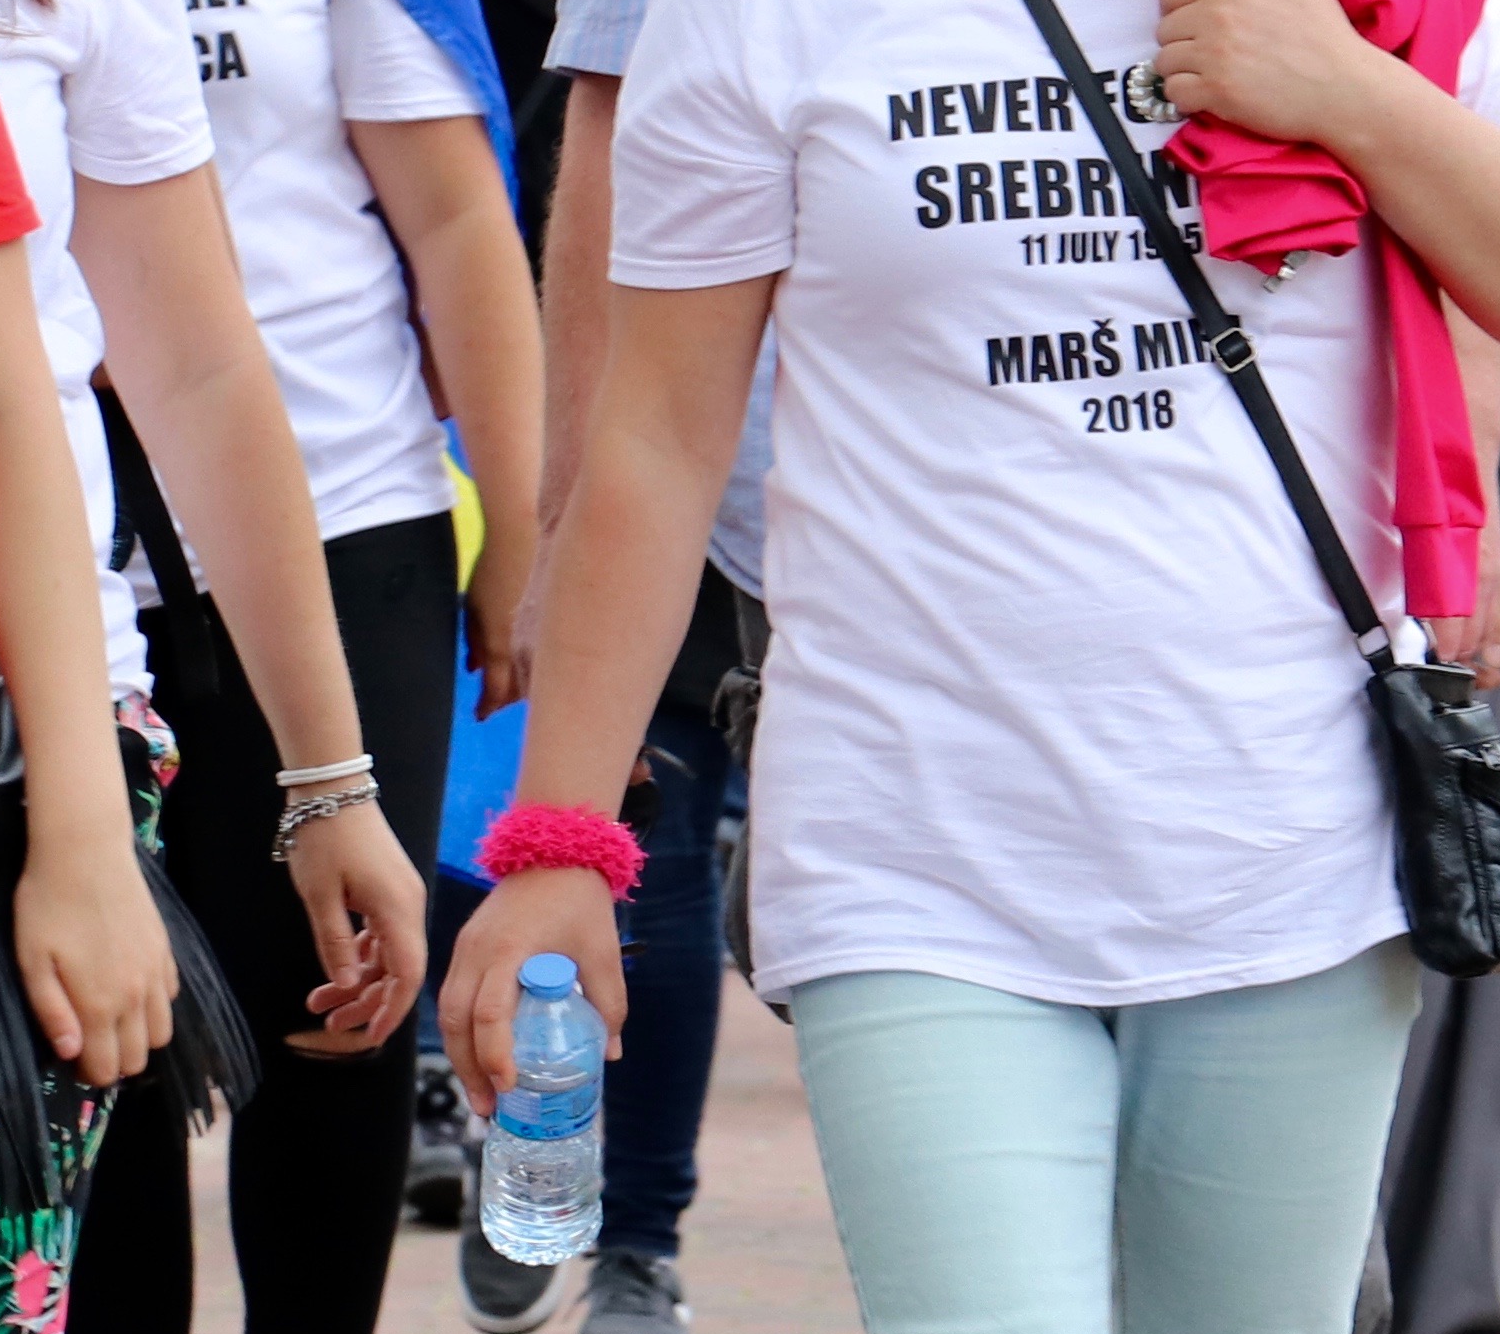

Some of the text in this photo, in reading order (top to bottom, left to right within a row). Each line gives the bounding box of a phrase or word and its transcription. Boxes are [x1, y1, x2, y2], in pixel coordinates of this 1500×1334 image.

[888, 76, 1076, 141] NEVER
[1021, 235, 1050, 266] 11
[1058, 230, 1122, 264] JULY
[986, 318, 1122, 386] MARŠ
[1082, 388, 1177, 434] 2018
